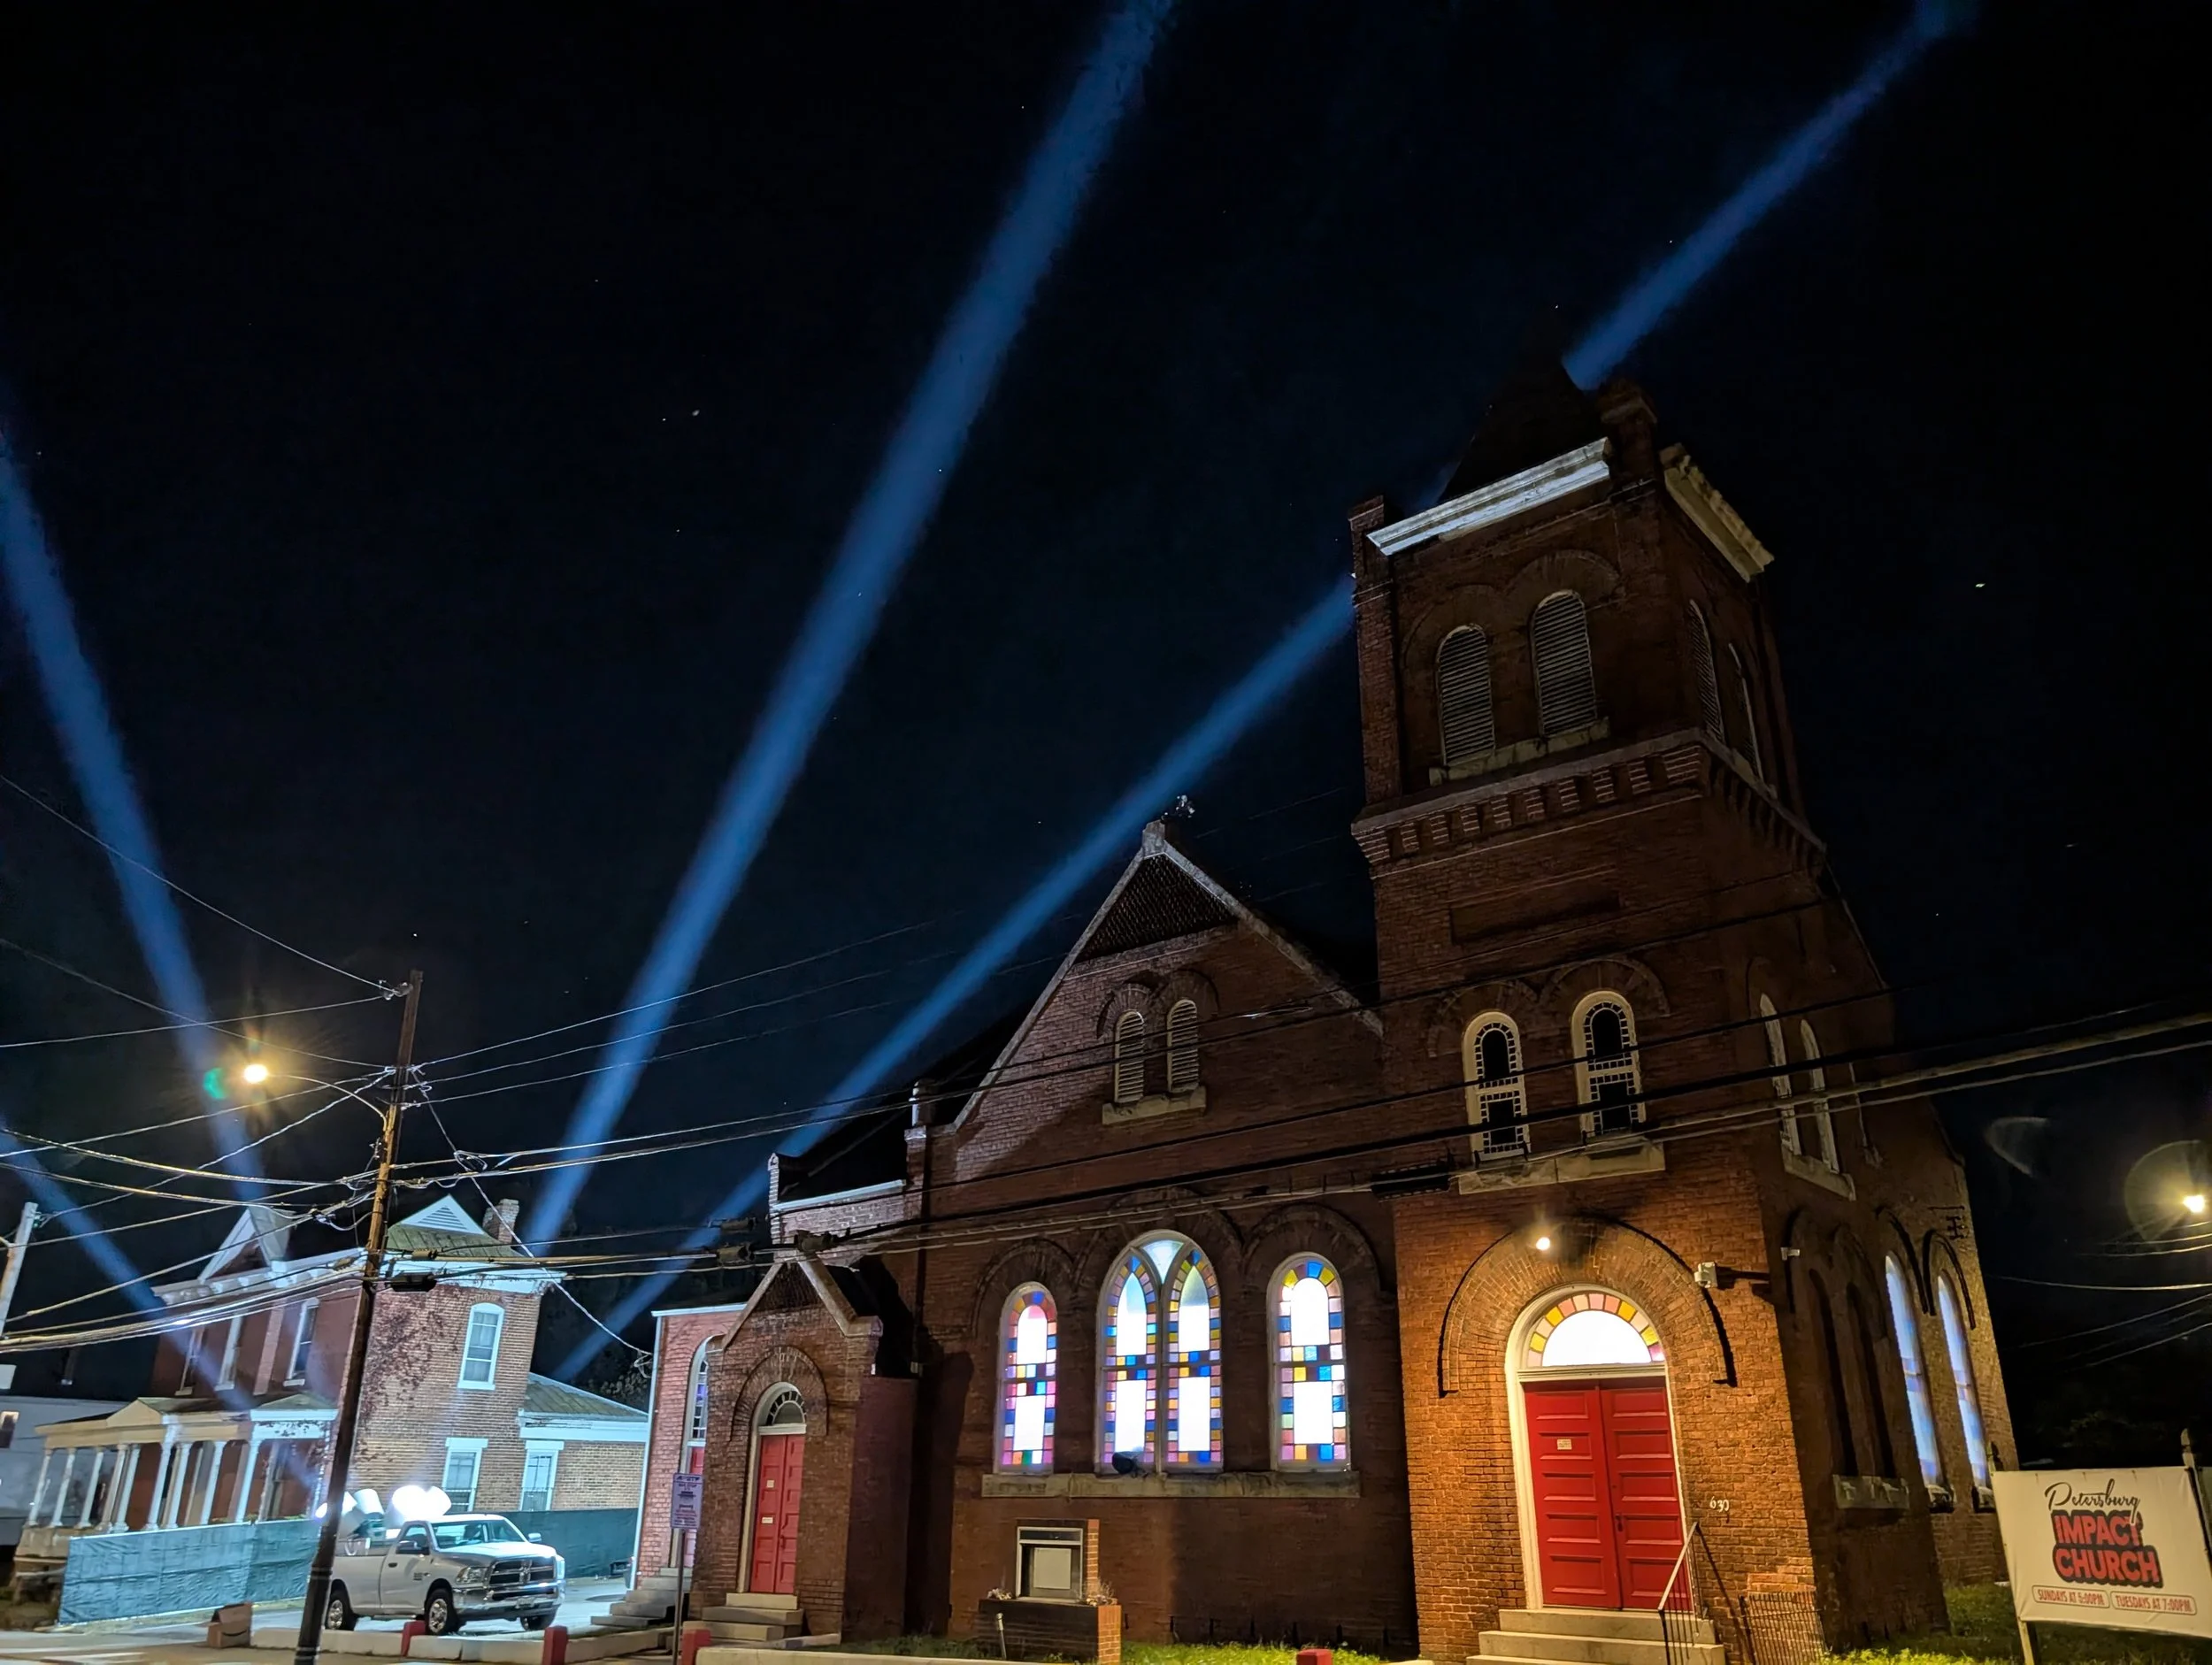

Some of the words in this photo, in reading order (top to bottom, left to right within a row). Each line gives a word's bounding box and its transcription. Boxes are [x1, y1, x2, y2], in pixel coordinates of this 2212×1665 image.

[2044, 1478, 2140, 1523] Petersburg
[2054, 1515, 2140, 1546] IMPACT
[2055, 1548, 2159, 1583] CHURCH
[2038, 1589, 2068, 1602] SUNDAYS
[2069, 1592, 2077, 1603] AT
[2116, 1595, 2151, 1609] TUESDAYS
[2152, 1597, 2161, 1610] AT
